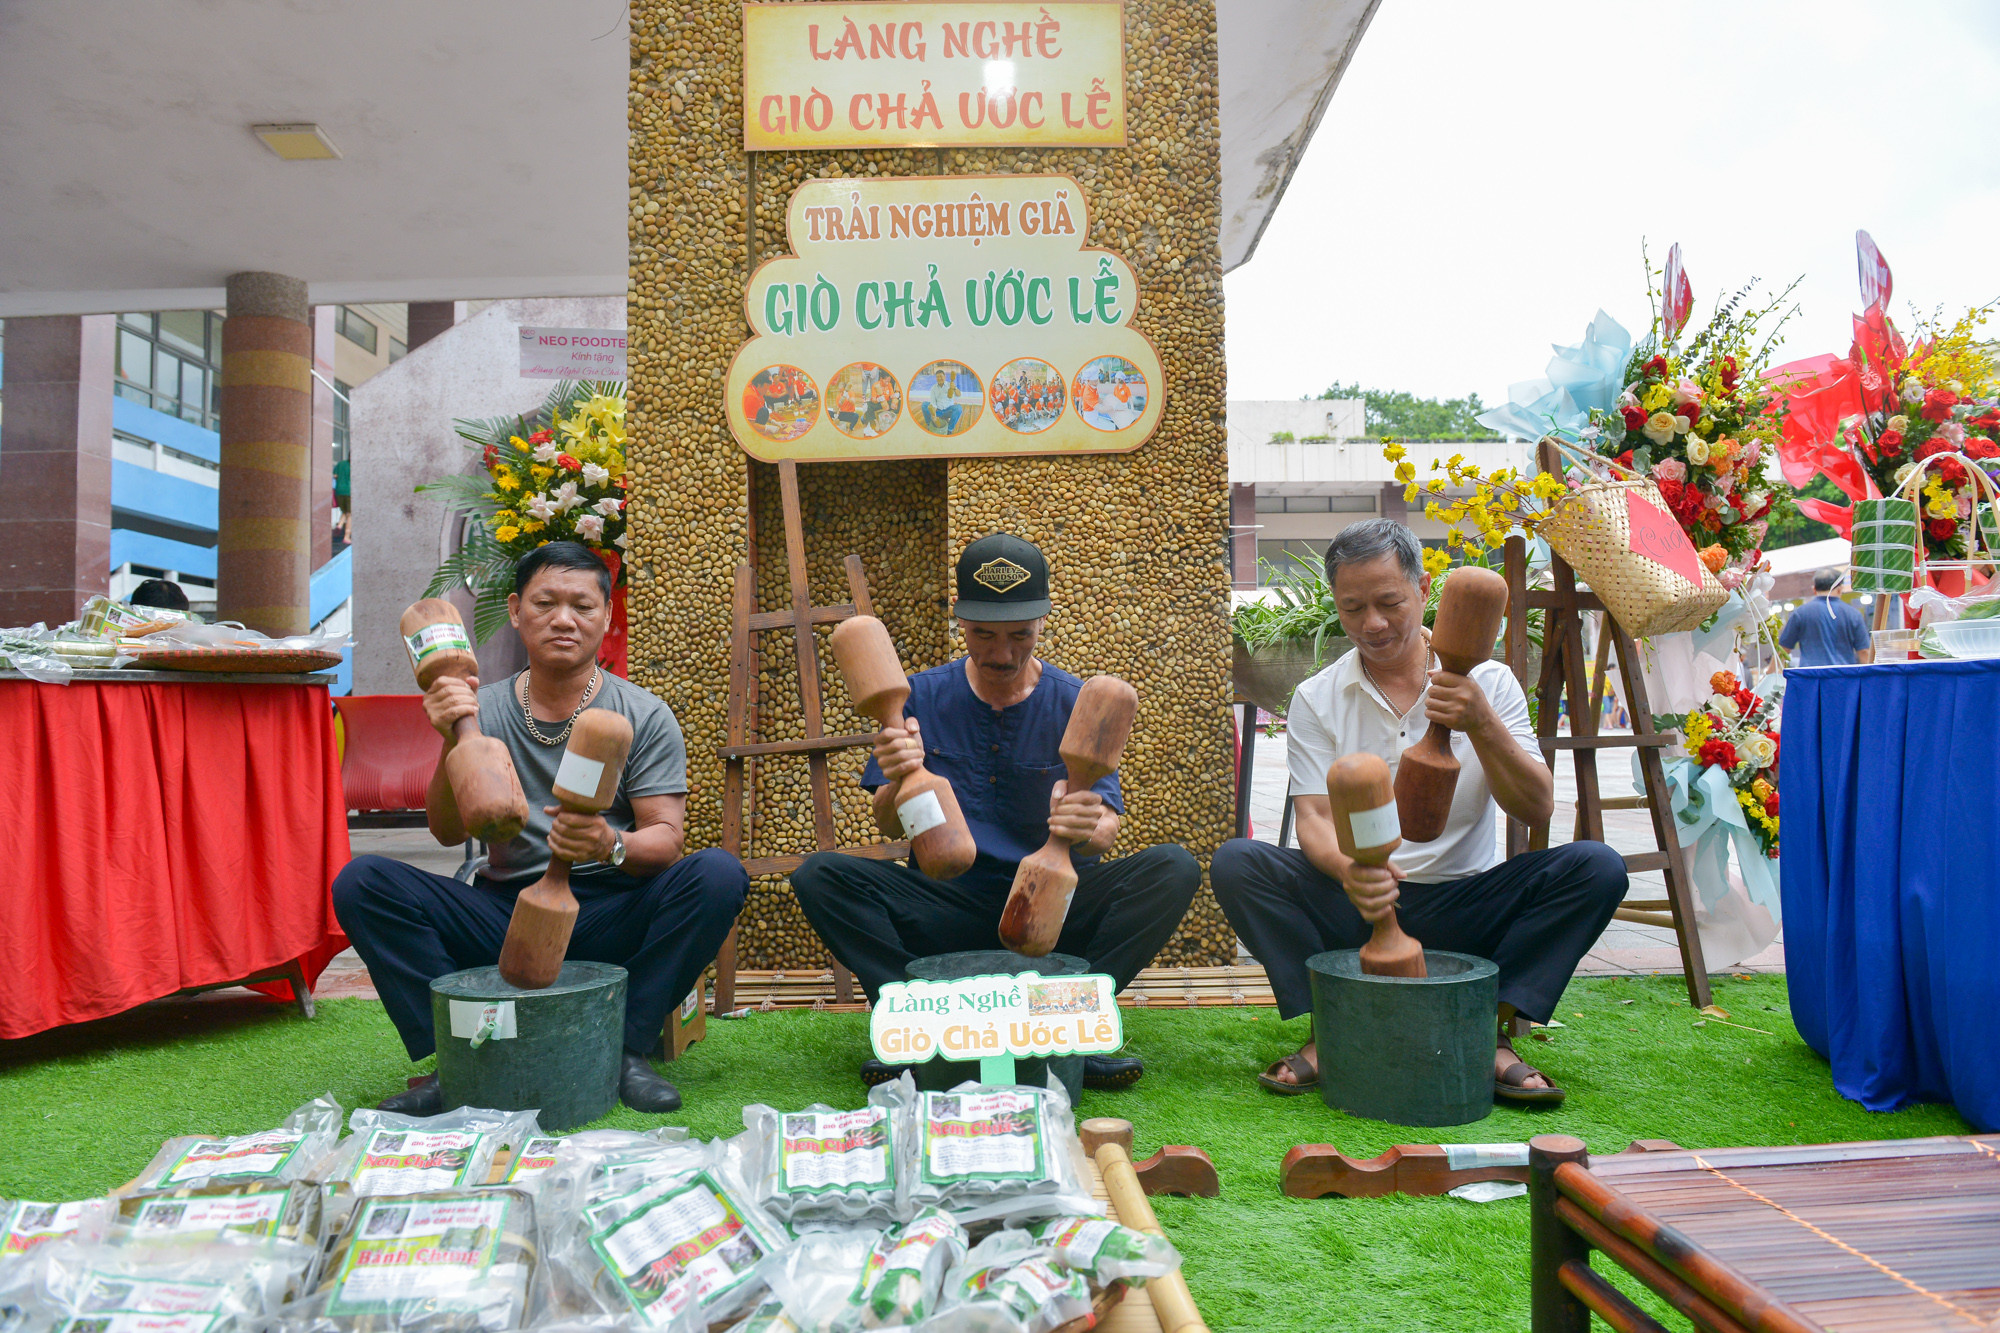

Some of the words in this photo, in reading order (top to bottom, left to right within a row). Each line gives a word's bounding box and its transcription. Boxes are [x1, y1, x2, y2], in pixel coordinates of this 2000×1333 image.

[808, 15, 926, 62] LÀNG
[942, 6, 1063, 60] NGHỀ
[758, 86, 833, 135] GIÒ
[849, 80, 944, 130] CHẢ
[1061, 77, 1114, 130] LỄ
[804, 191, 881, 241] TRẢI
[888, 192, 1012, 247] NGHIỆM
[1019, 190, 1076, 236] GIÃ
[765, 273, 840, 336] GIÒ
[855, 264, 952, 331] CHẢ
[966, 268, 1053, 327] ƯỚC
[1069, 257, 1123, 324] LỄ
[538, 335, 568, 346] NEO
[571, 336, 627, 349] FOODTE
[571, 351, 592, 361] Kính
[593, 352, 615, 364] tặng
[981, 573, 1025, 582] DAVIDSON
[888, 993, 950, 1015] Làng
[958, 985, 1022, 1013] Nghề
[880, 1027, 931, 1053] Giò
[943, 1022, 999, 1050] Chả
[1009, 1020, 1068, 1048] Ước
[1077, 1014, 1113, 1045] Lễ
[930, 1120, 965, 1136] Nem
[970, 1120, 1013, 1136] Chua
[784, 1137, 820, 1153] Nem
[823, 1137, 864, 1153] Chua
[363, 1153, 400, 1168] Nem
[403, 1154, 442, 1169] Chua
[518, 1157, 555, 1169] Nem
[699, 1213, 744, 1247] Nem
[651, 1242, 701, 1273] Chua
